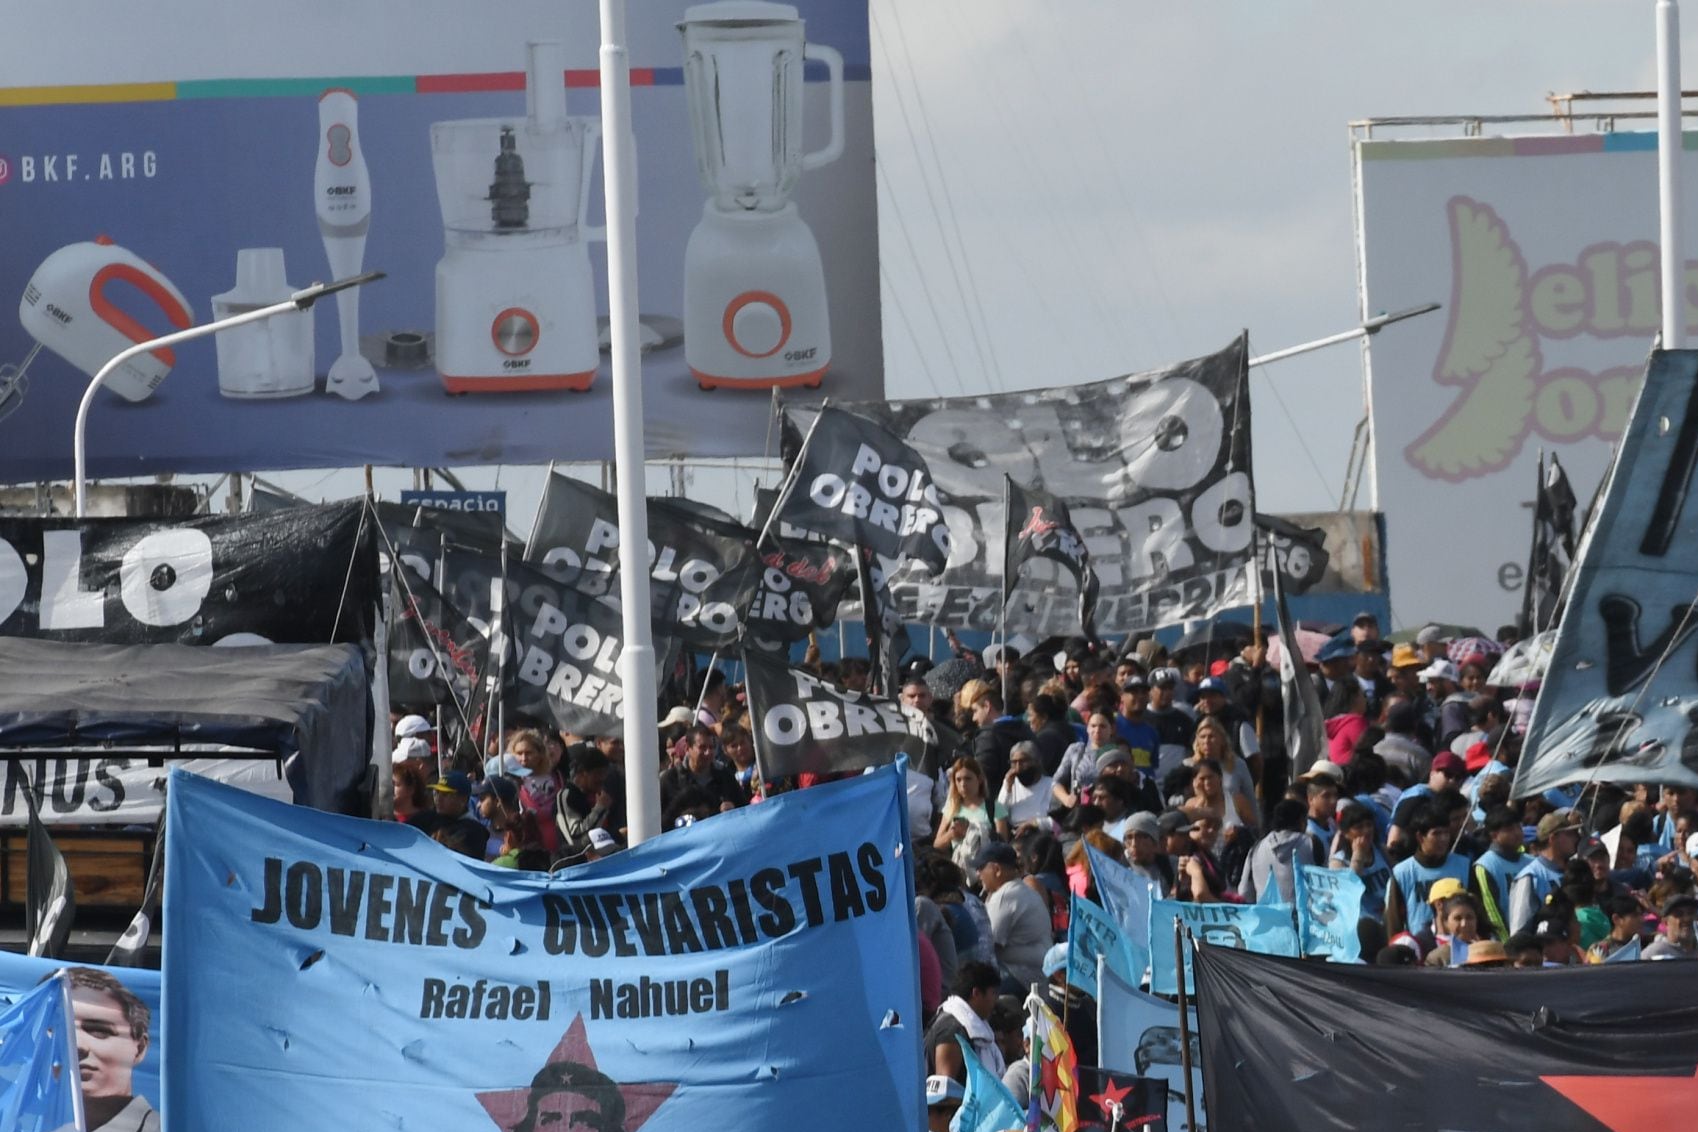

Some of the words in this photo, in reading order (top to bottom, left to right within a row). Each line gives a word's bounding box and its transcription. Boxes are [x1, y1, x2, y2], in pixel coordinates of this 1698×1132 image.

[21, 150, 157, 183] BKF.ARG
[794, 347, 818, 362] BKF
[531, 601, 624, 683] POL
[251, 856, 494, 949] JOVENES
[543, 841, 888, 958] GUEVARISTAS
[1183, 904, 1242, 923] MTR
[420, 976, 552, 1021] Rafael
[590, 968, 730, 1021] Nahuel
